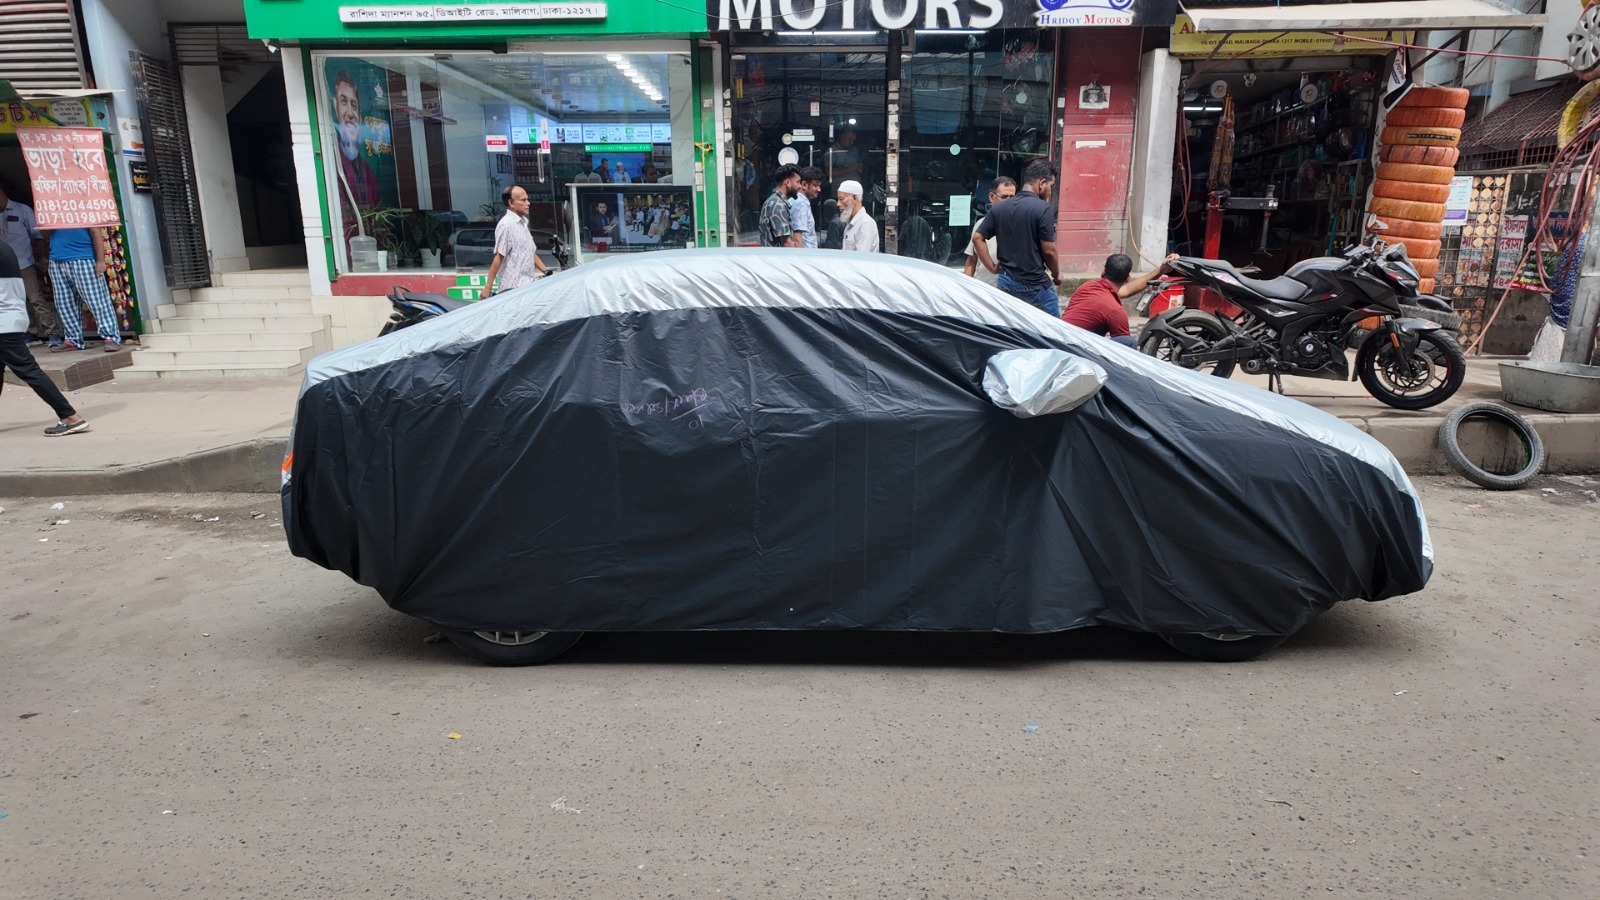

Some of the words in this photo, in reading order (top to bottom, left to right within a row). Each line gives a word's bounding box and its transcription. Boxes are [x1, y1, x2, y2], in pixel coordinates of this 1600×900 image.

[349, 9, 378, 18] রাশিদা
[380, 10, 413, 18] ম্যানশন
[436, 7, 472, 17] ডিআইটি
[717, 0, 1004, 30] MOTORS
[1040, 14, 1082, 25] HRIDOY
[1083, 14, 1131, 25] MOTOR'S
[85, 134, 100, 144] তলা
[23, 146, 67, 175] ভাড়া
[68, 147, 105, 172] হবে
[35, 199, 116, 212] 01812044590
[37, 212, 118, 224] 01710198135
